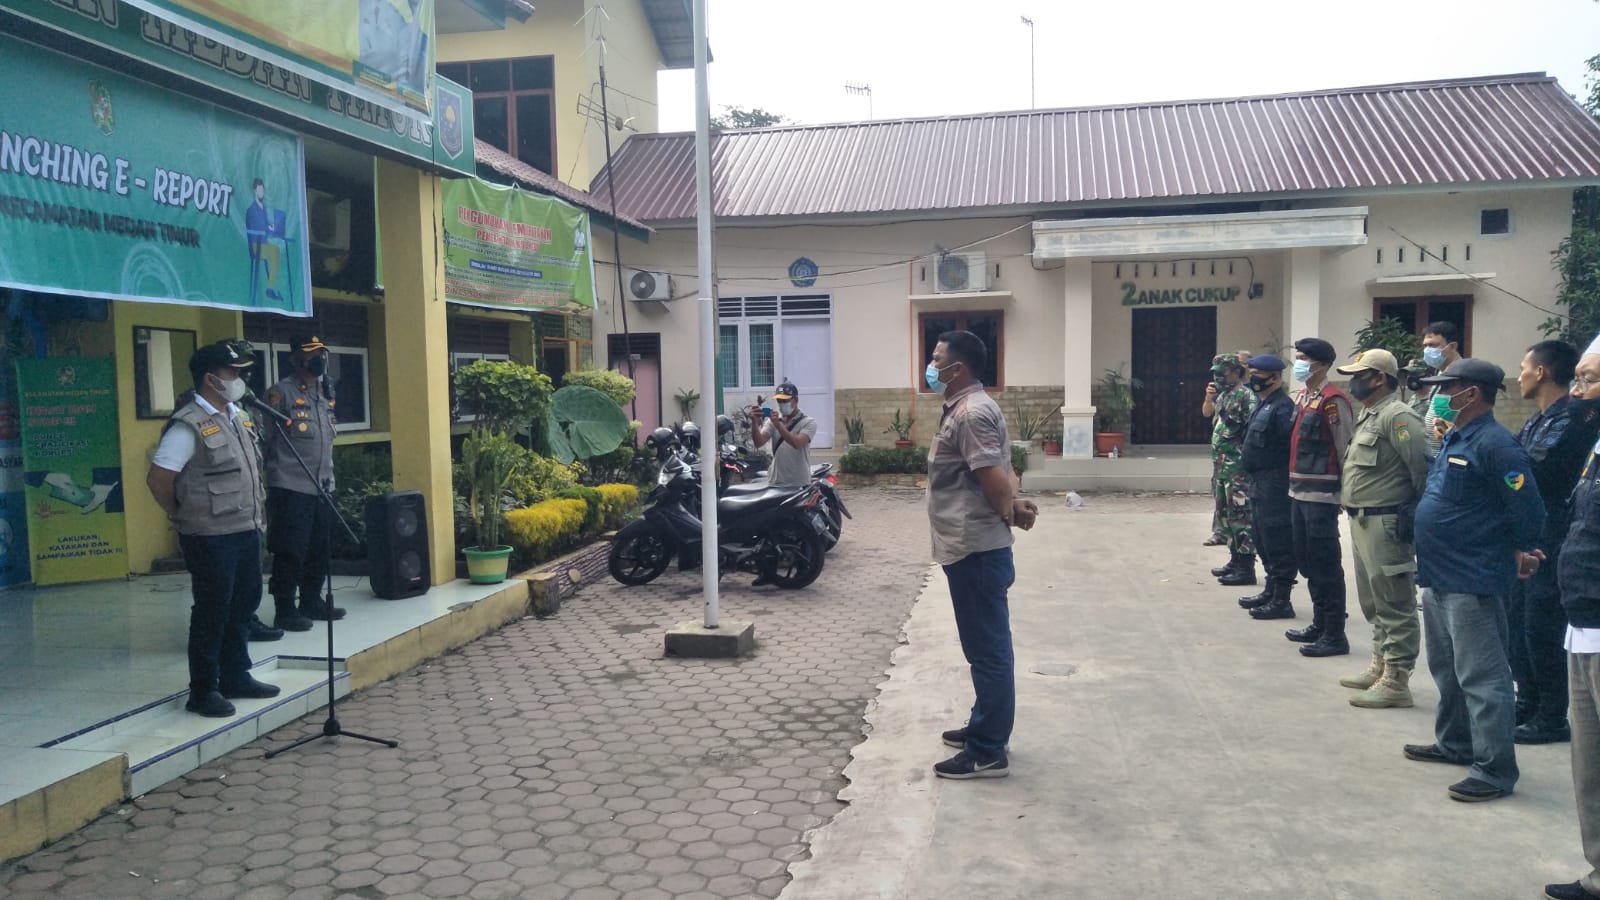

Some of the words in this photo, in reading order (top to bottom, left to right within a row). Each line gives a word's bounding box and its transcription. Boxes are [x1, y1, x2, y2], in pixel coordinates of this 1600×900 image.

[1, 131, 109, 191] NCHING
[115, 157, 130, 195] E
[153, 168, 233, 216] REPORT
